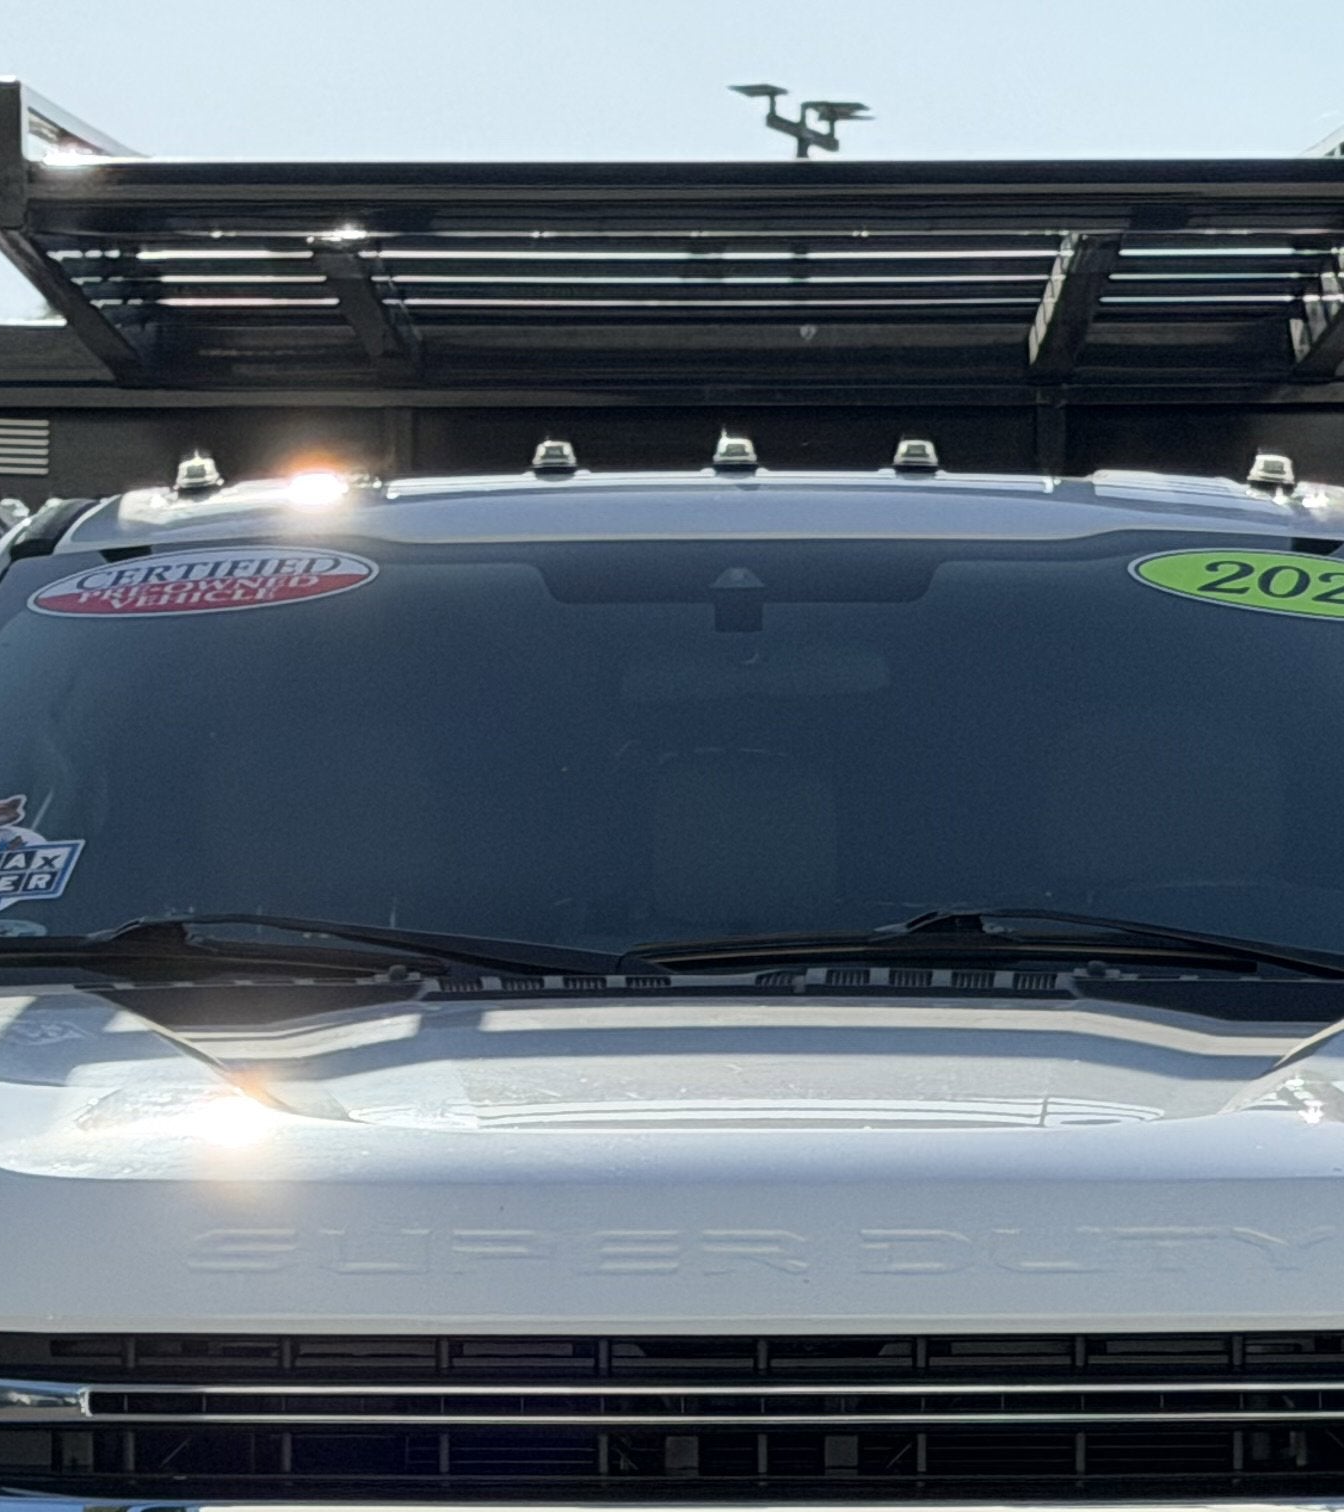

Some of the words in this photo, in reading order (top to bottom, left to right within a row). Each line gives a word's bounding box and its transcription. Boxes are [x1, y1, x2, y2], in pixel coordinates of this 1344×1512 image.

[76, 556, 342, 591] CERTIFIED
[77, 575, 320, 605] PRE-OWNED
[109, 588, 277, 610] VEHICLE
[186, 1227, 810, 1276] SUPER
[857, 1224, 1338, 1275] DUTY
